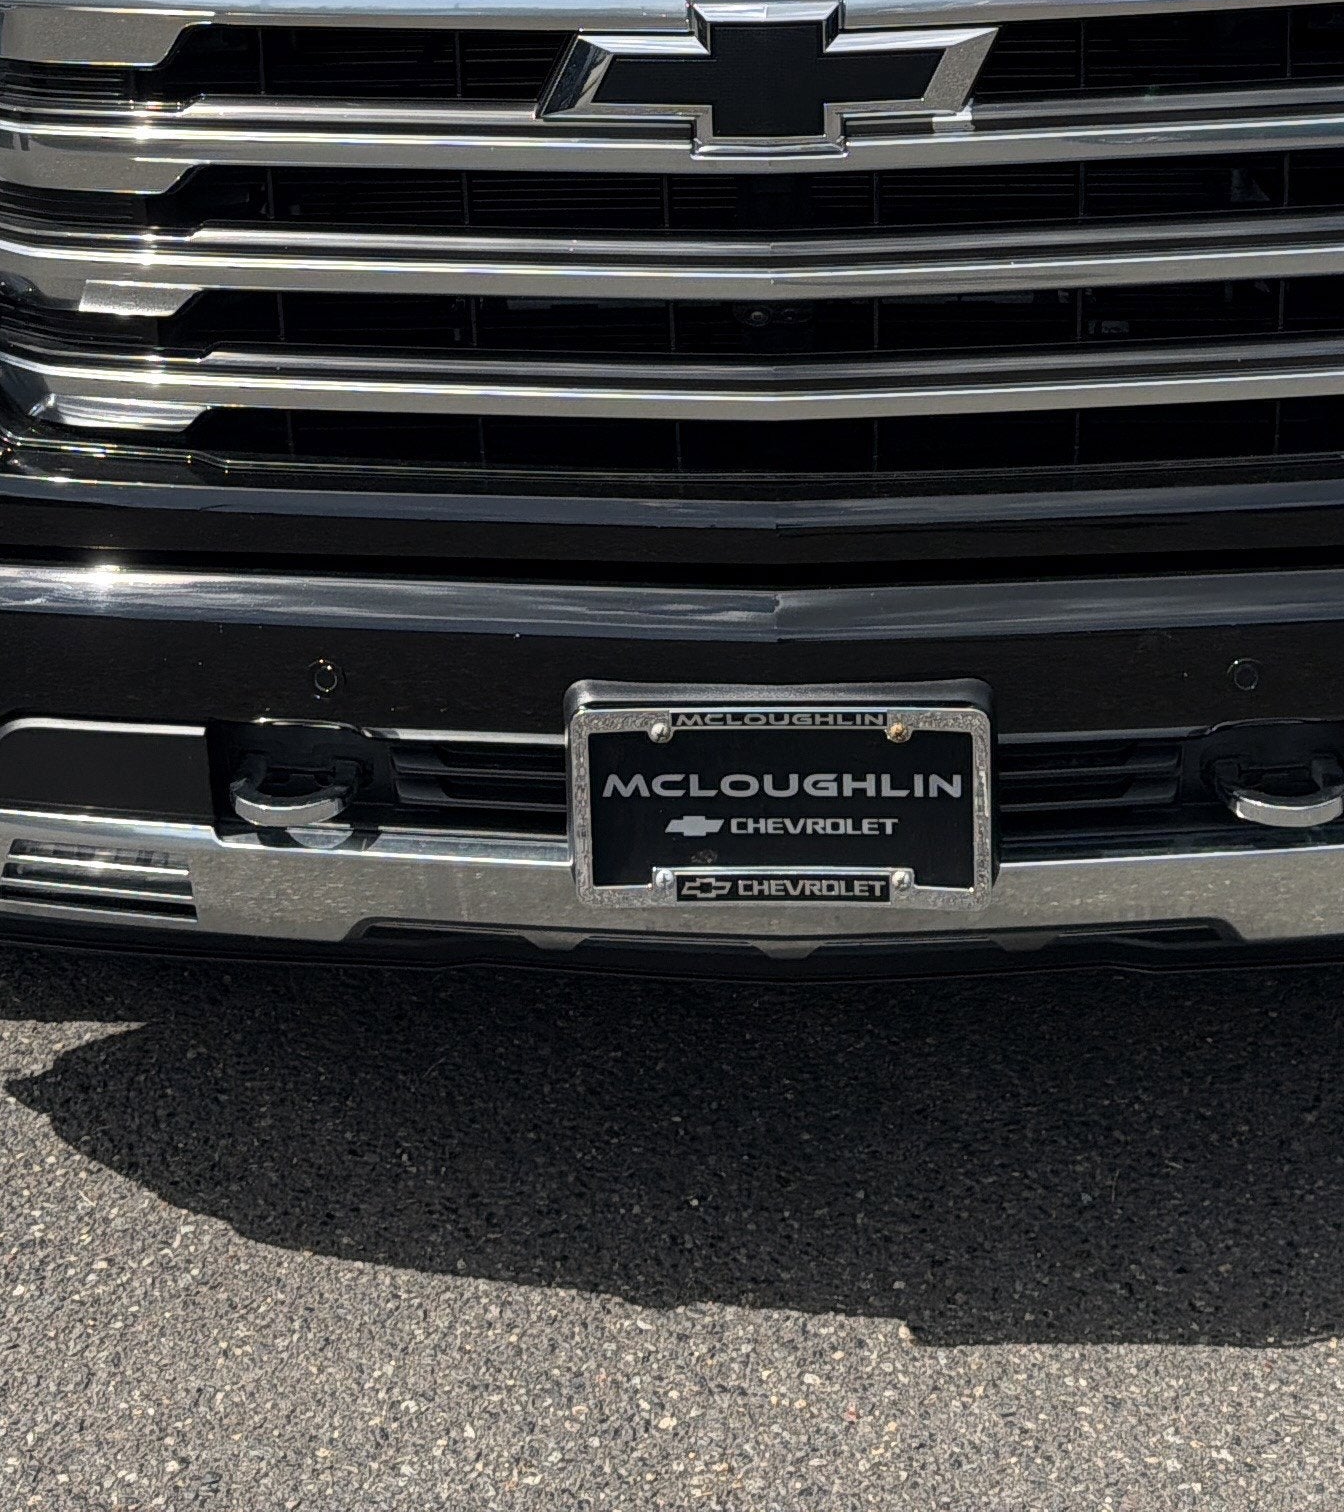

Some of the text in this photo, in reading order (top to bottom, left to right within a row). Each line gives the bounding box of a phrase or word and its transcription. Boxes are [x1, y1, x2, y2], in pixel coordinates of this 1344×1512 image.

[675, 712, 886, 727] MCLOUGHLIN
[602, 773, 963, 799] MCLOUGHLIN
[730, 817, 899, 836] CHEVROLET
[738, 878, 887, 898] CHEVROLET
